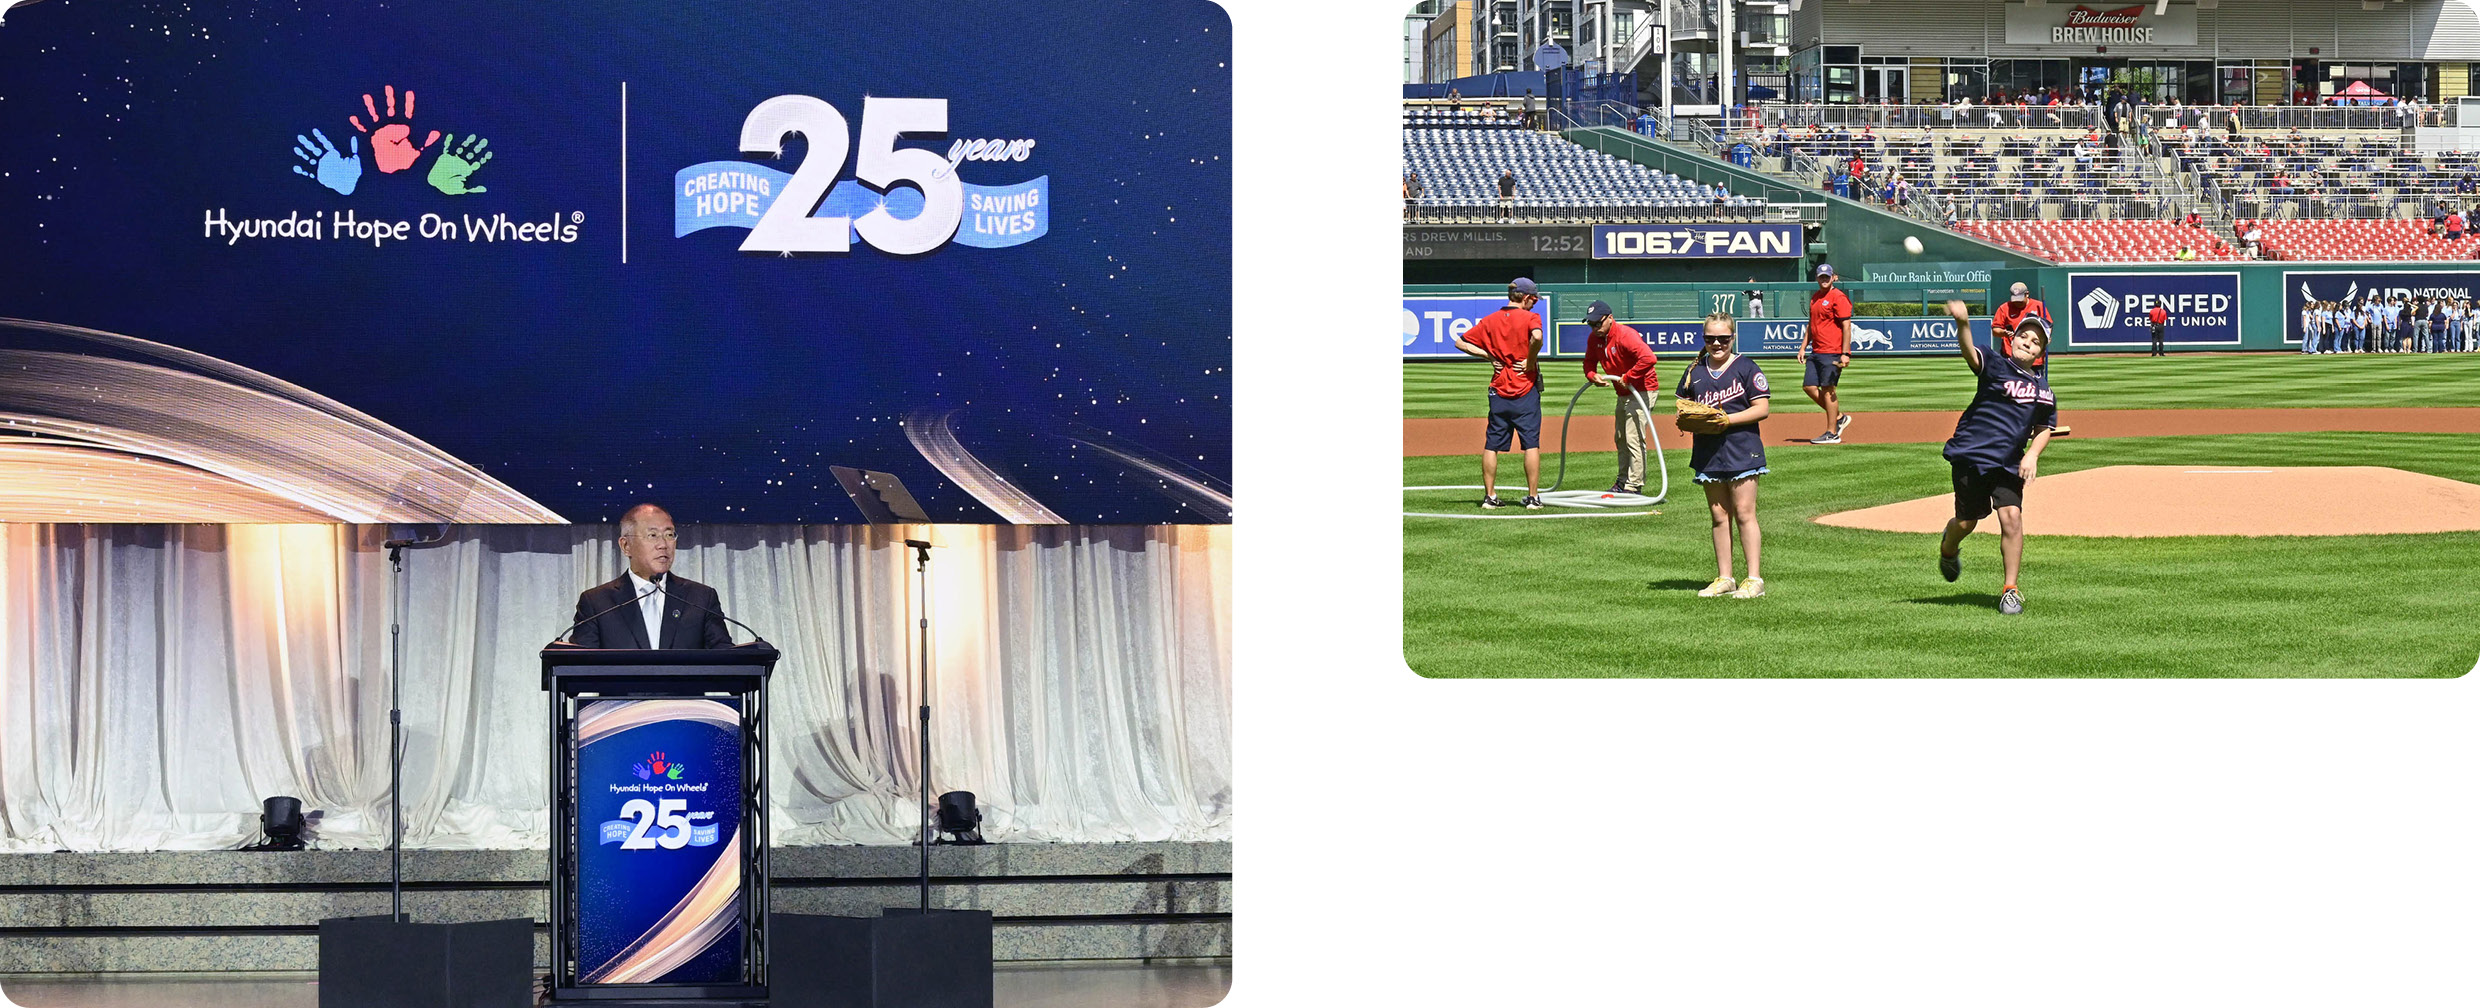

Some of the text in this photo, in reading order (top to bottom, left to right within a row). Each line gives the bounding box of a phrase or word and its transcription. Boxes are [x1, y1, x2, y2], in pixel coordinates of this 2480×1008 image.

[2069, 11, 2138, 24] Budweiser
[2052, 26, 2154, 43] BREW HOUSE
[931, 136, 1035, 179] years
[738, 94, 963, 255] 25
[684, 171, 770, 198] CREATING
[697, 190, 760, 218] HOPE
[970, 187, 1039, 214] SAVING
[204, 207, 322, 246] Hyundai
[333, 209, 410, 247] Hope
[419, 213, 457, 241] On
[975, 211, 1036, 237] LIVES
[1421, 232, 1459, 242] DREW
[1531, 235, 1584, 252] 12:52
[1705, 230, 1791, 254] FAN
[1406, 247, 1433, 256] AND
[1872, 270, 1991, 282] Put Our Bank in Your Offic
[2413, 287, 2472, 299] NATIONAL
[1711, 293, 1736, 315] 377
[2124, 294, 2230, 313] PENFED
[2124, 316, 2227, 327] CREIT UNION
[1638, 331, 1696, 345] LEAR
[609, 783, 641, 794] Hyundai
[643, 783, 663, 794] Hope
[665, 784, 676, 792] On
[603, 823, 631, 833] CREATING
[619, 798, 692, 850] 25
[693, 827, 716, 836] SAVING
[606, 830, 627, 839] HOPE
[694, 834, 715, 843] LIVES
